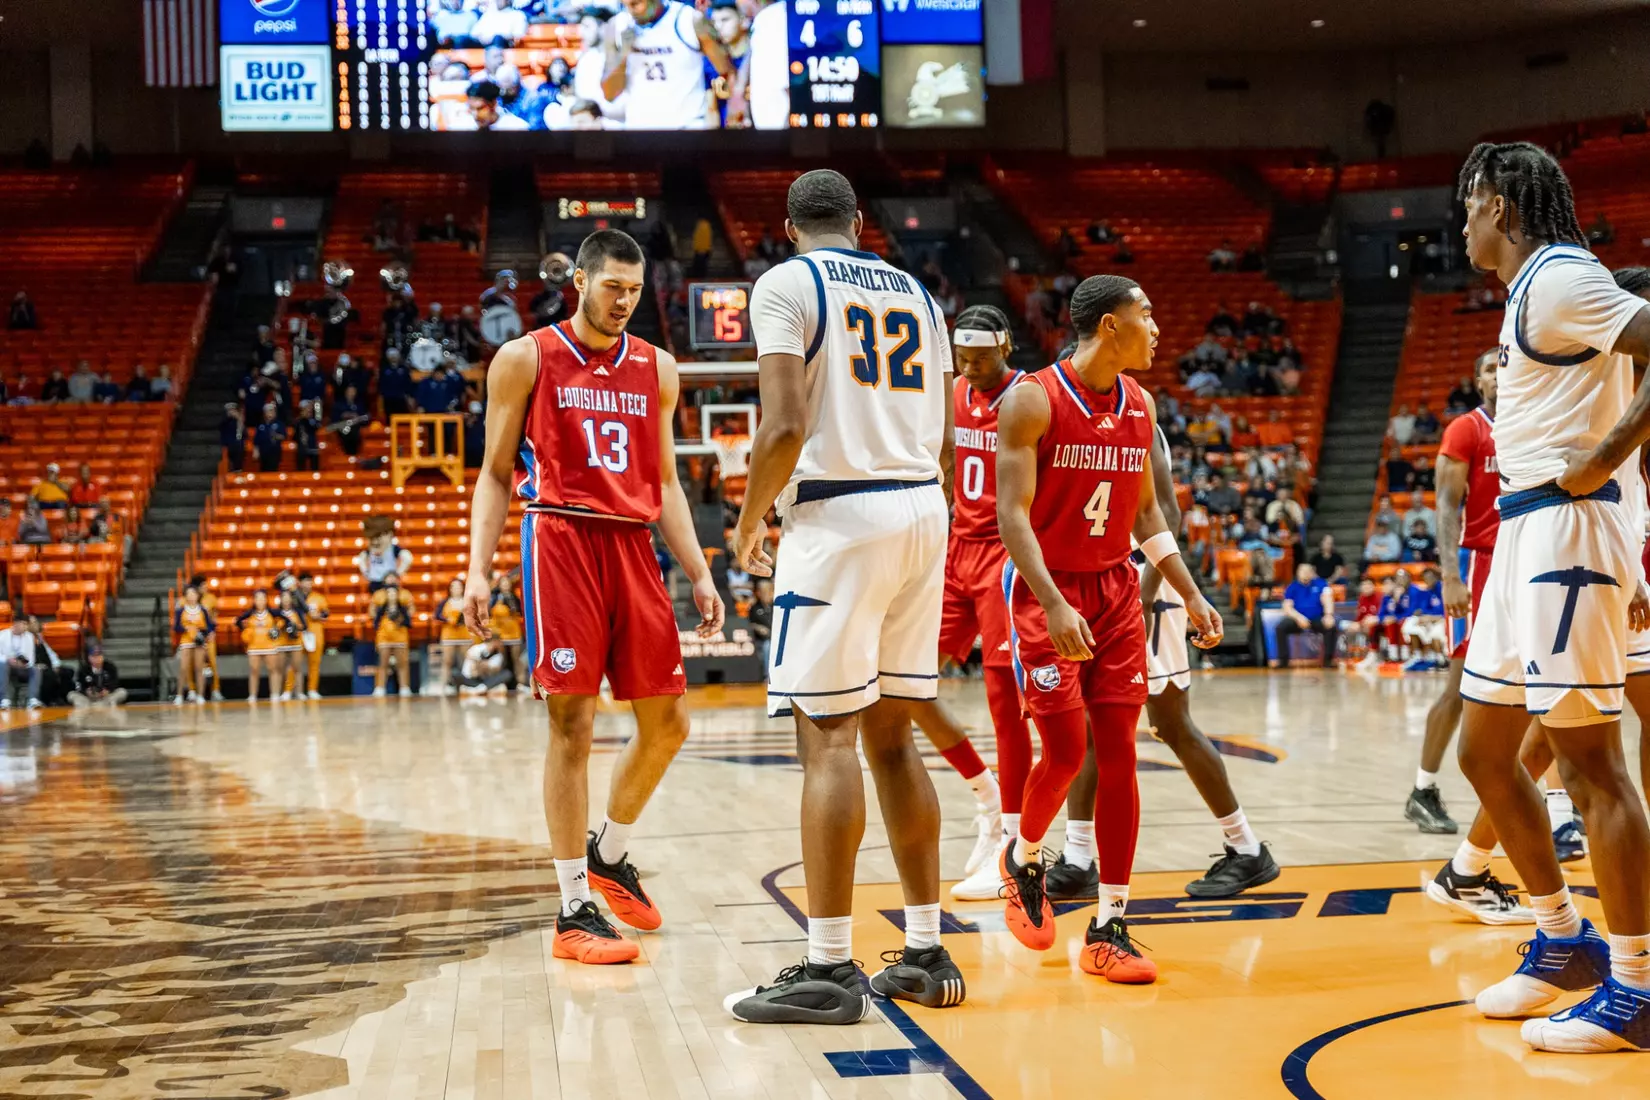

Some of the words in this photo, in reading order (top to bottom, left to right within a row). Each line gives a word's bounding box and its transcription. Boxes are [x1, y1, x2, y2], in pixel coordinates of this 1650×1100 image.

[254, 18, 297, 35] pepsi
[800, 19, 817, 48] 4
[847, 19, 863, 48] 6
[246, 62, 305, 80] BUD
[235, 83, 317, 101] LIGHT
[822, 260, 914, 295] HAMILTON
[714, 309, 742, 342] 15
[843, 301, 925, 393] 32
[556, 386, 618, 412] LOUISIANA
[619, 393, 648, 417] TECH
[582, 417, 630, 474] 13
[985, 431, 998, 452] TE
[1052, 444, 1118, 471] LOUISIANA
[962, 455, 985, 501] 0
[1083, 481, 1112, 537] 4
